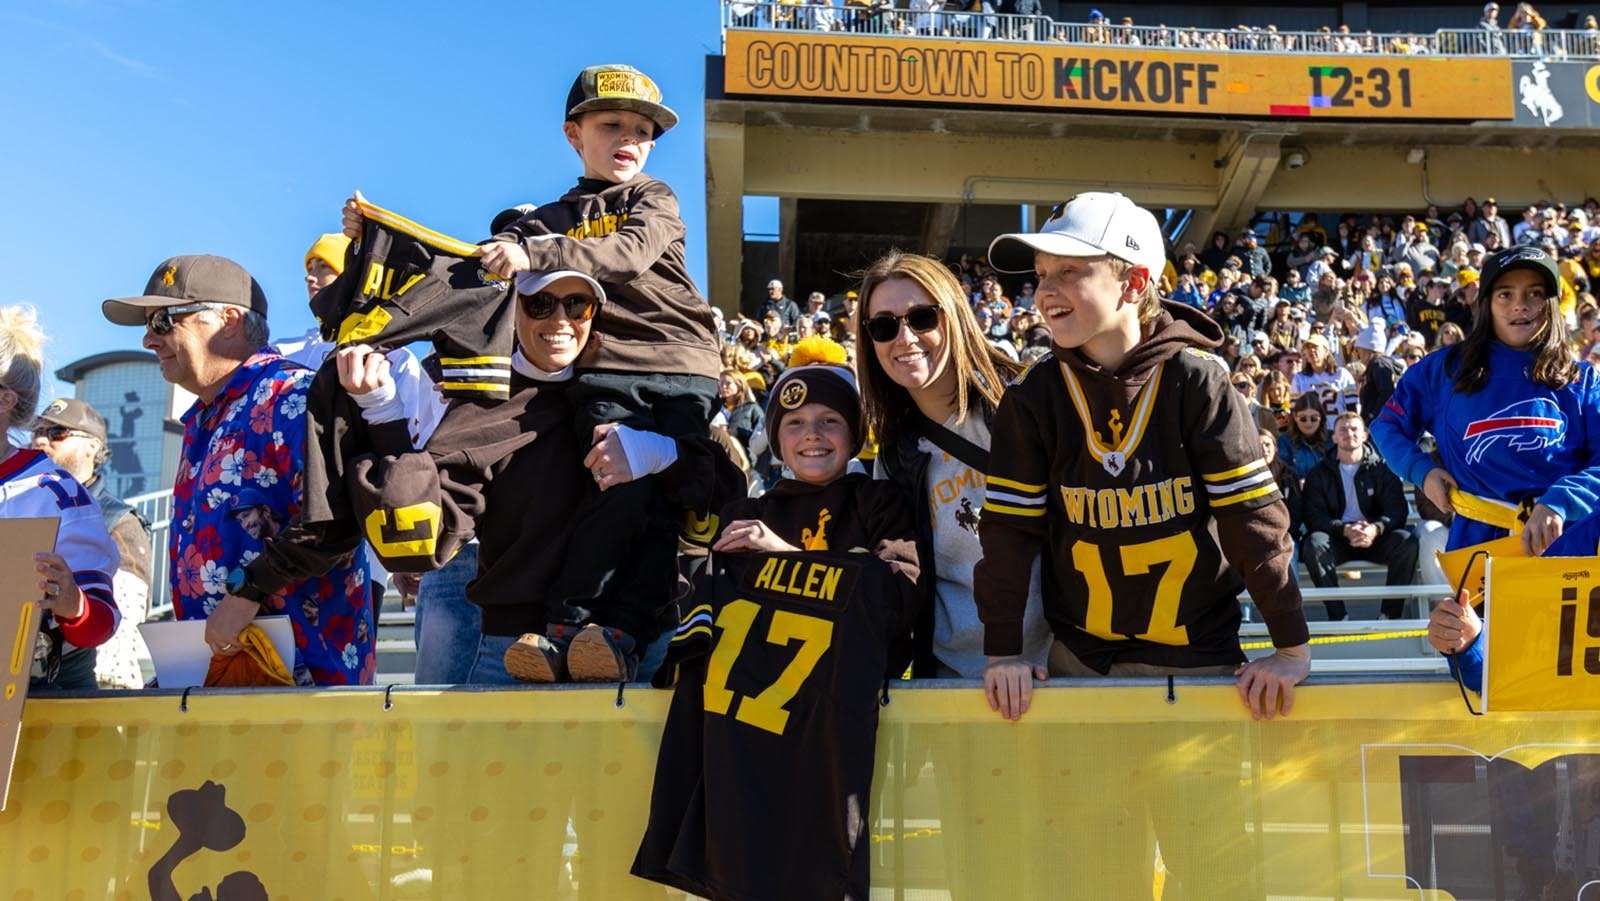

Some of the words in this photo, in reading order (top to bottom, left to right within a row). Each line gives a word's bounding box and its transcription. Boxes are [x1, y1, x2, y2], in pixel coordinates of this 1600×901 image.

[599, 83, 636, 93] COMPANY
[747, 39, 987, 98] COUNTDOWN
[995, 52, 1045, 100] TO
[1053, 57, 1219, 106] KICKOFF
[1309, 66, 1411, 108] 12:31
[1060, 475, 1195, 529] WYOMING
[754, 557, 844, 601] ALLEN
[1071, 529, 1199, 646] 17
[703, 599, 834, 736] 17
